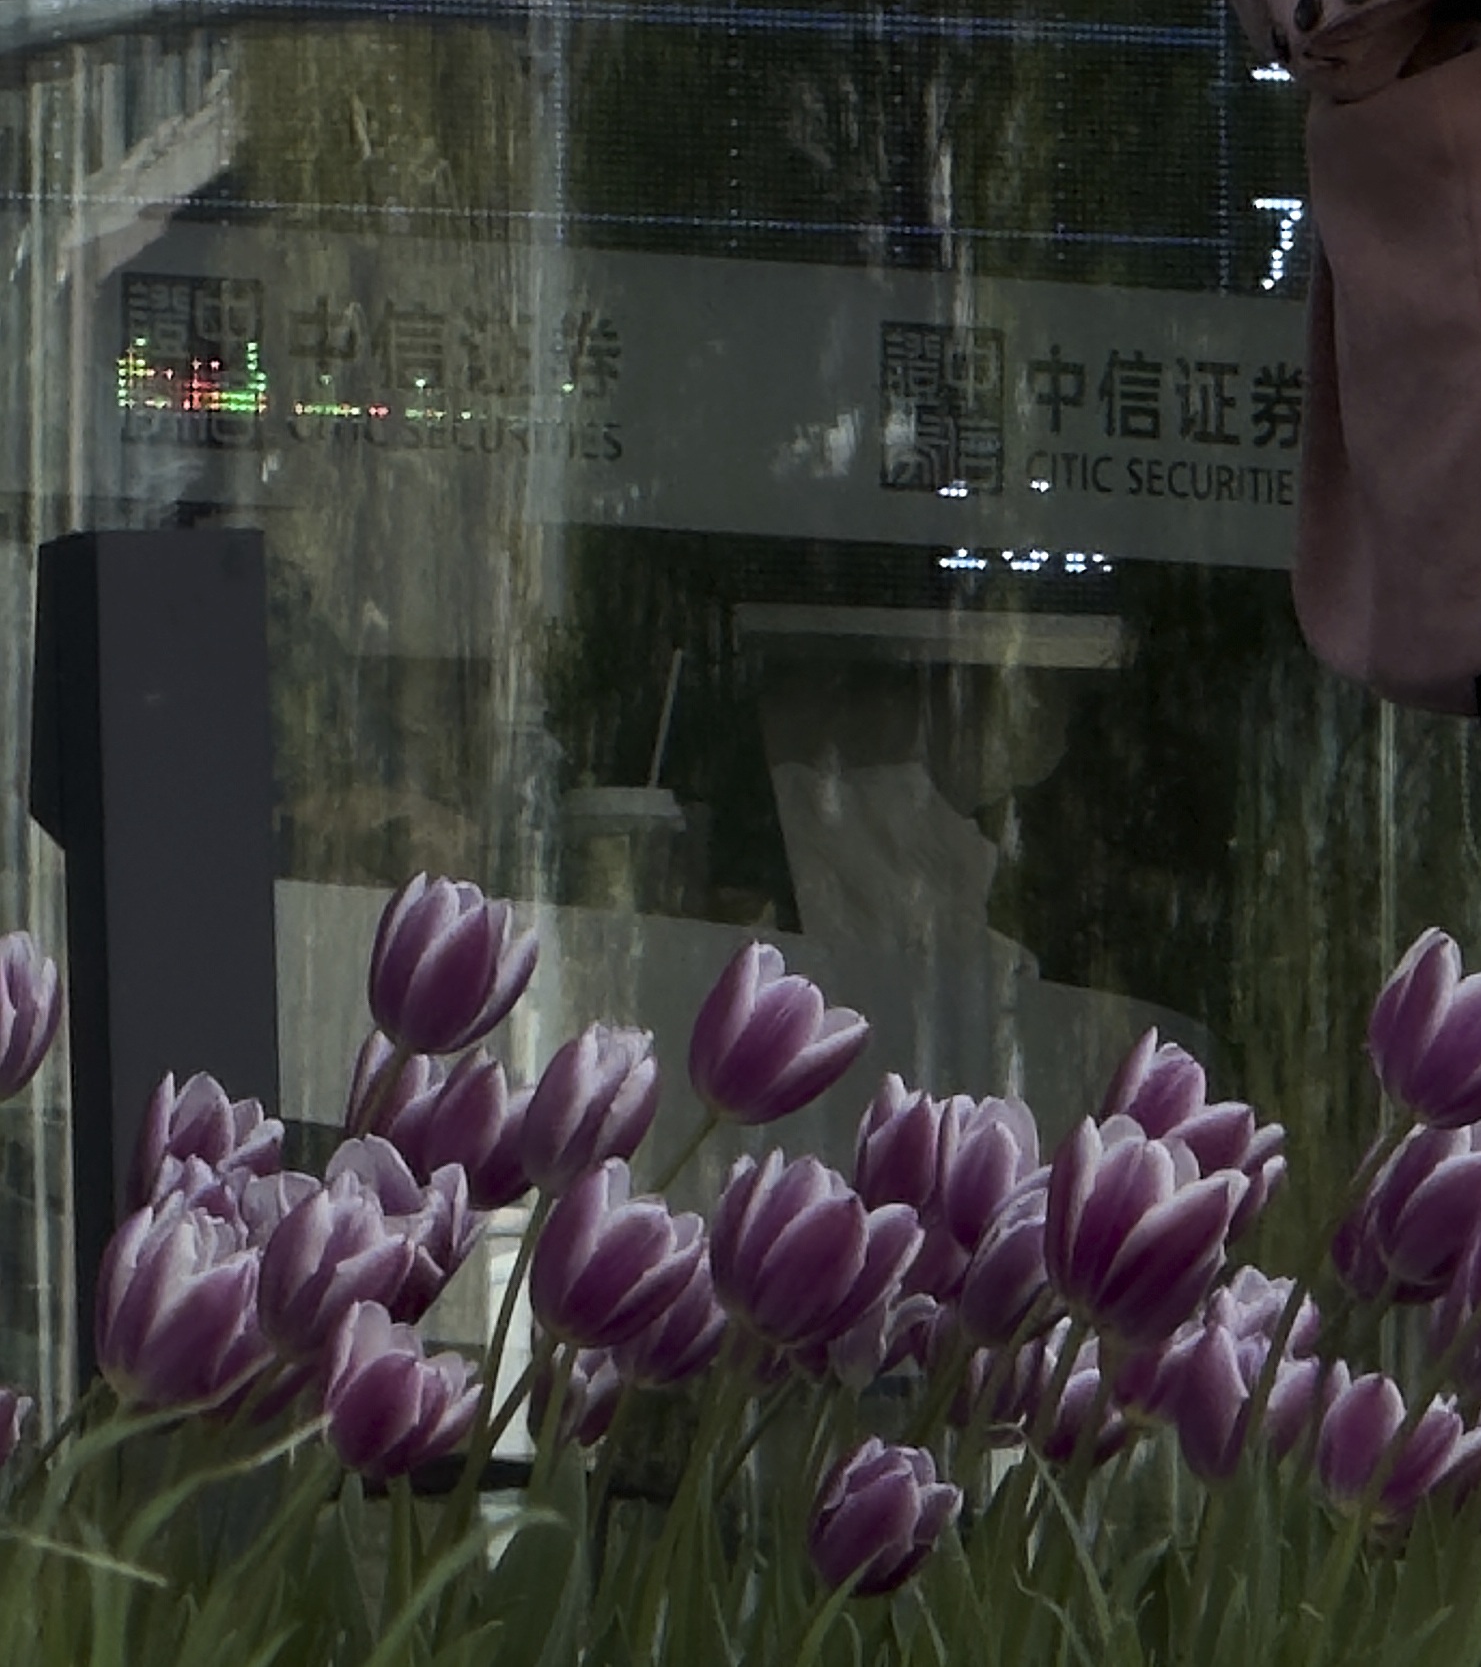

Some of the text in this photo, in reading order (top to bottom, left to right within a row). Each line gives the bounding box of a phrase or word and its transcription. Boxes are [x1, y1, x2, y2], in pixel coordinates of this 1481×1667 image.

[1028, 343, 1302, 448] 中信证券
[1126, 456, 1295, 506] SECURITIE
